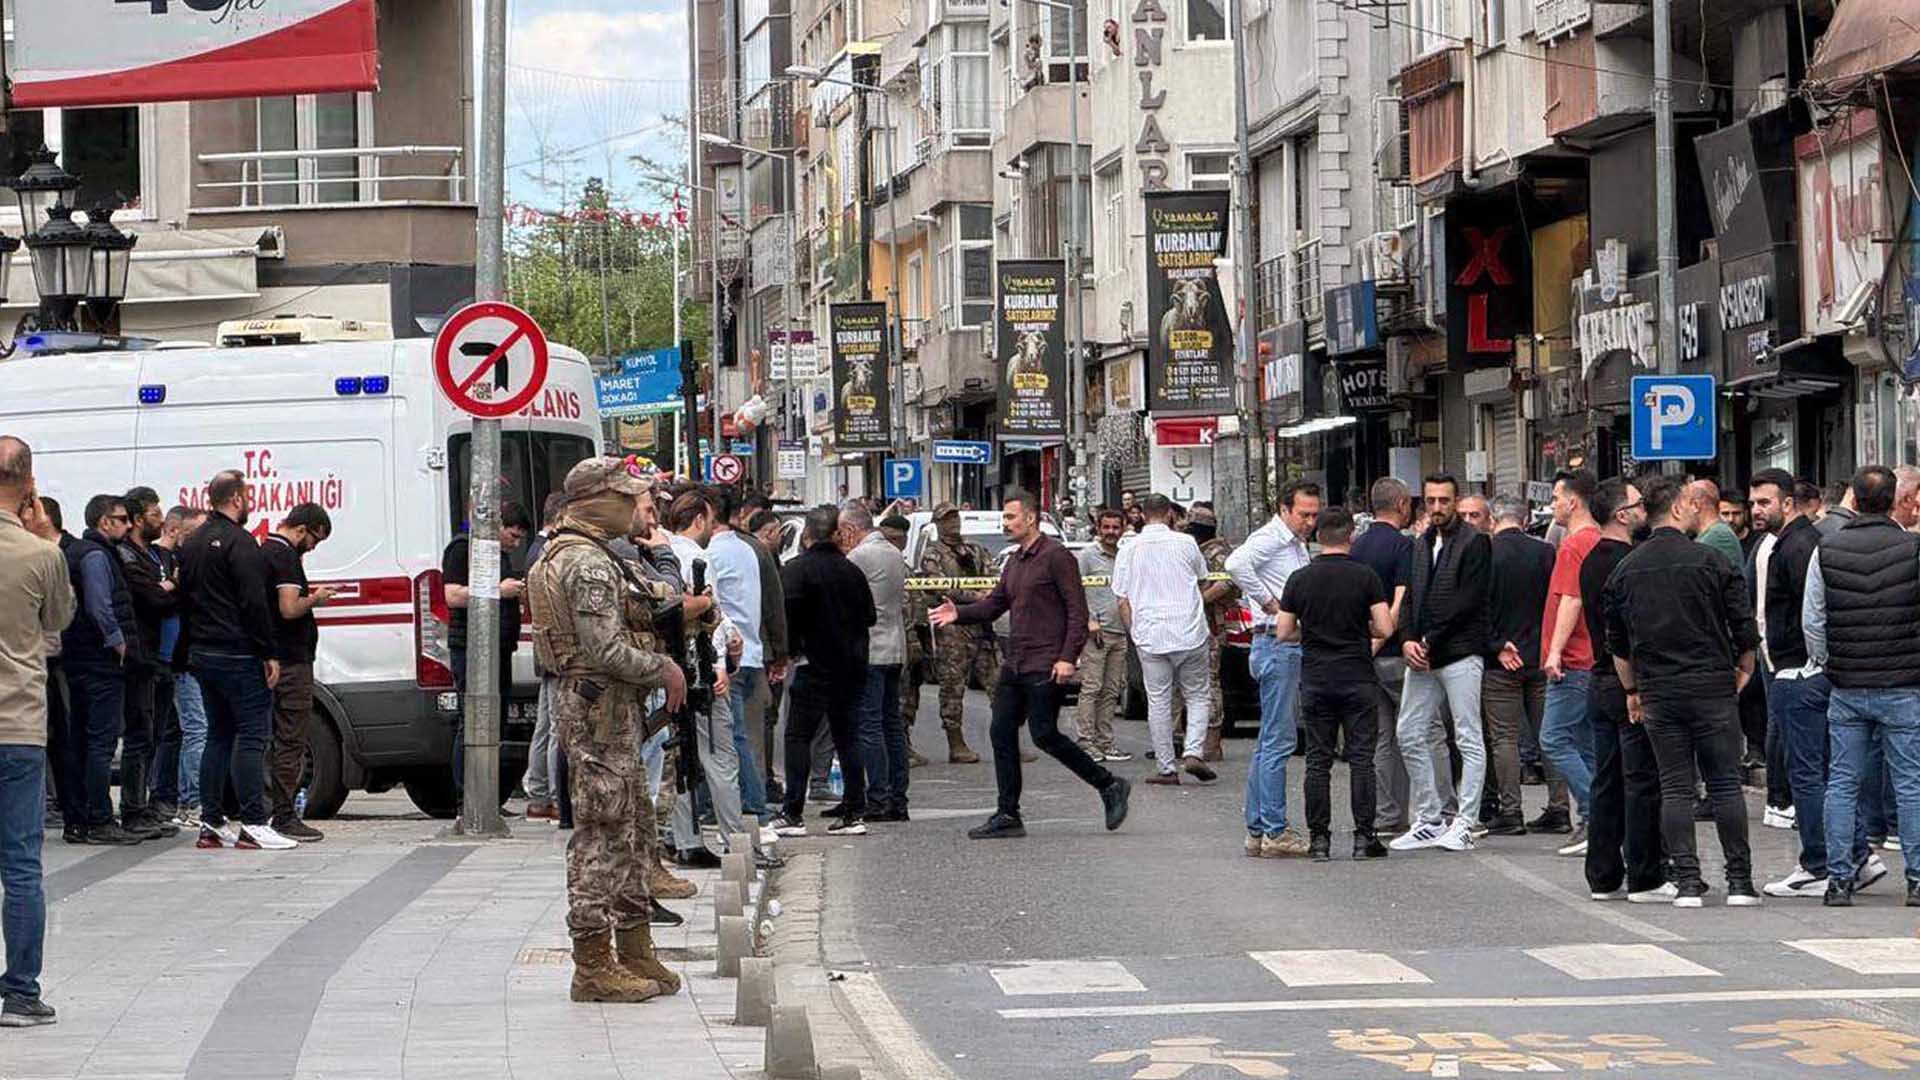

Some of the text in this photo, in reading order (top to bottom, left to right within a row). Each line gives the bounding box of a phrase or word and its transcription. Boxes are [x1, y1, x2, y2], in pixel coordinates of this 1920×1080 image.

[1004, 294, 1058, 309] KURBANLIK
[1342, 369, 1388, 395] HOTE
[1651, 385, 1695, 450] P
[244, 450, 277, 479] T.C.
[247, 473, 342, 513] BAKANLIĞI
